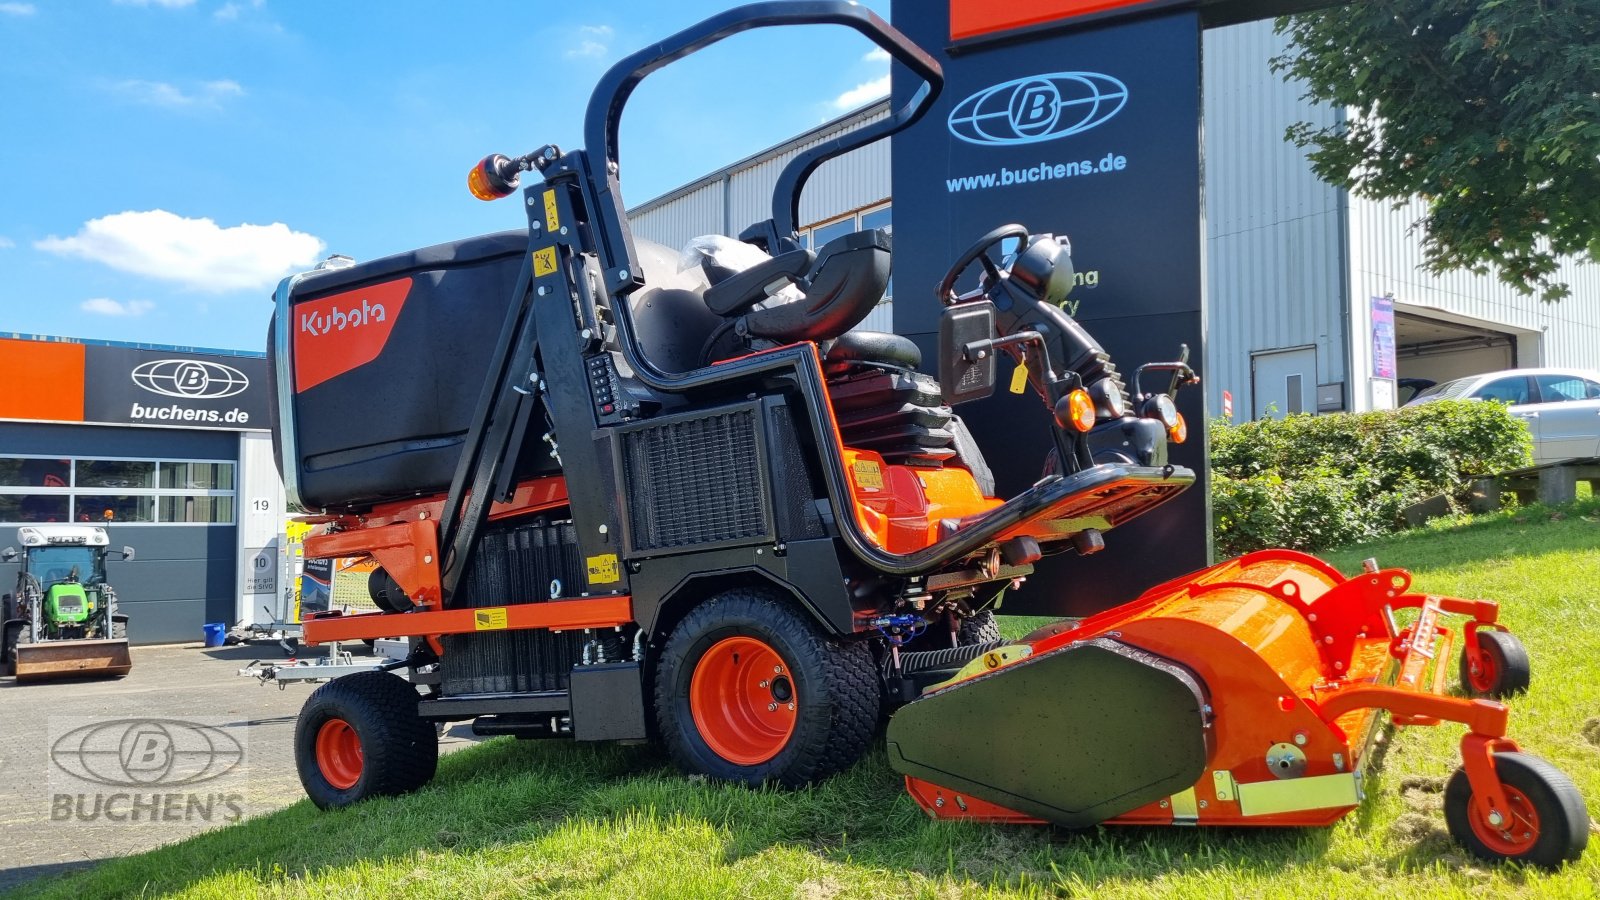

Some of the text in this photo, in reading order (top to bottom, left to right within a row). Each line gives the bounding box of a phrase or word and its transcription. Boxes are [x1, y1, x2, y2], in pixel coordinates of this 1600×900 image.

[1014, 85, 1058, 130] B
[945, 152, 1127, 193] www.buchens.de
[301, 299, 386, 337] Kubota
[178, 366, 208, 390] B
[130, 402, 249, 424] buchens.de
[253, 500, 269, 511] 19
[254, 557, 266, 568] 10
